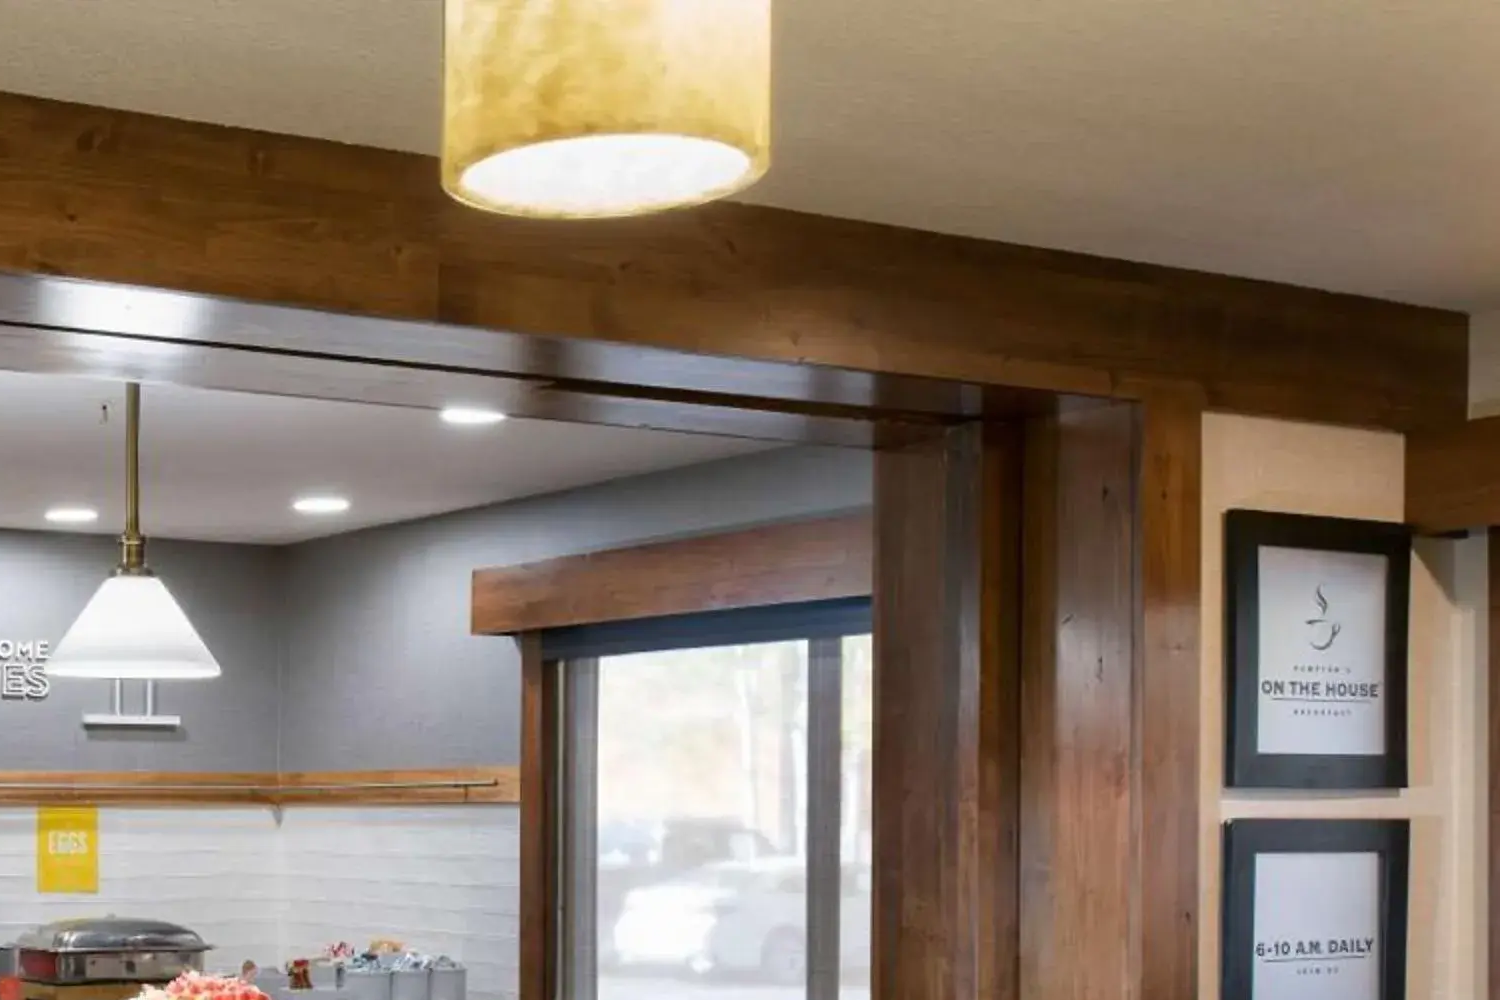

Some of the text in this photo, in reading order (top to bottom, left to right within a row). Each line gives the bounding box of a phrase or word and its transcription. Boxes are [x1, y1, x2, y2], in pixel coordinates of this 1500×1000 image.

[1261, 680, 1379, 698] ON THE HOUSE
[1256, 942, 1291, 957] 6-10
[1328, 938, 1374, 954] DAILY
